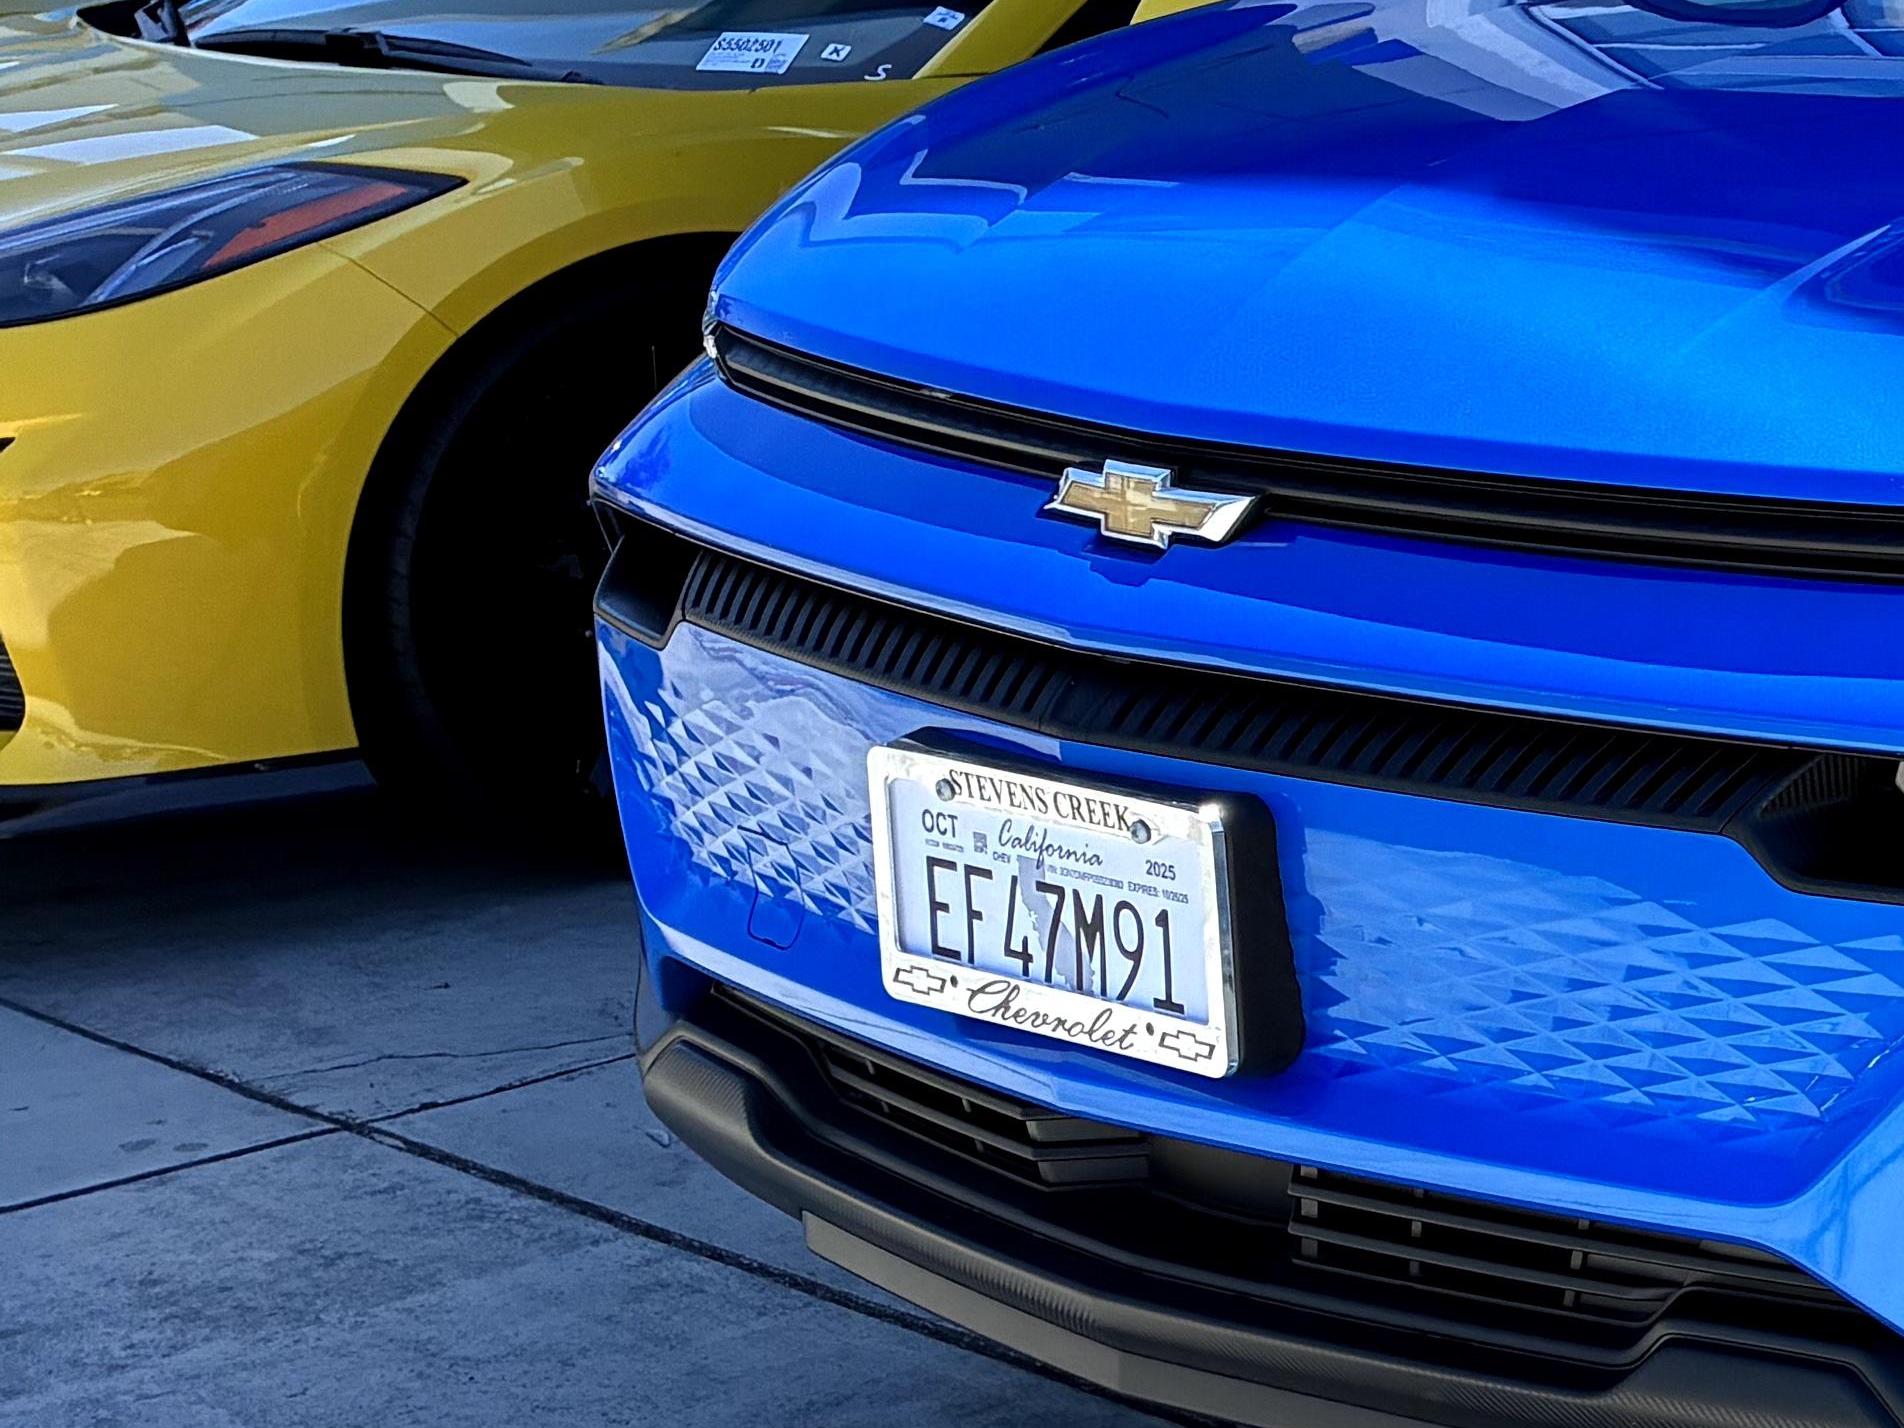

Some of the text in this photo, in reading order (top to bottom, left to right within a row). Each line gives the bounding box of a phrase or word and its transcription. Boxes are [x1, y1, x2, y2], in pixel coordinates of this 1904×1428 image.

[921, 808, 959, 839] OCT
[950, 769, 1131, 832] STEVENS CREEK
[998, 818, 1104, 871] California
[1145, 859, 1177, 882] 2025
[925, 855, 1187, 1016] EF47M91
[965, 979, 1138, 1052] Chevrolet
